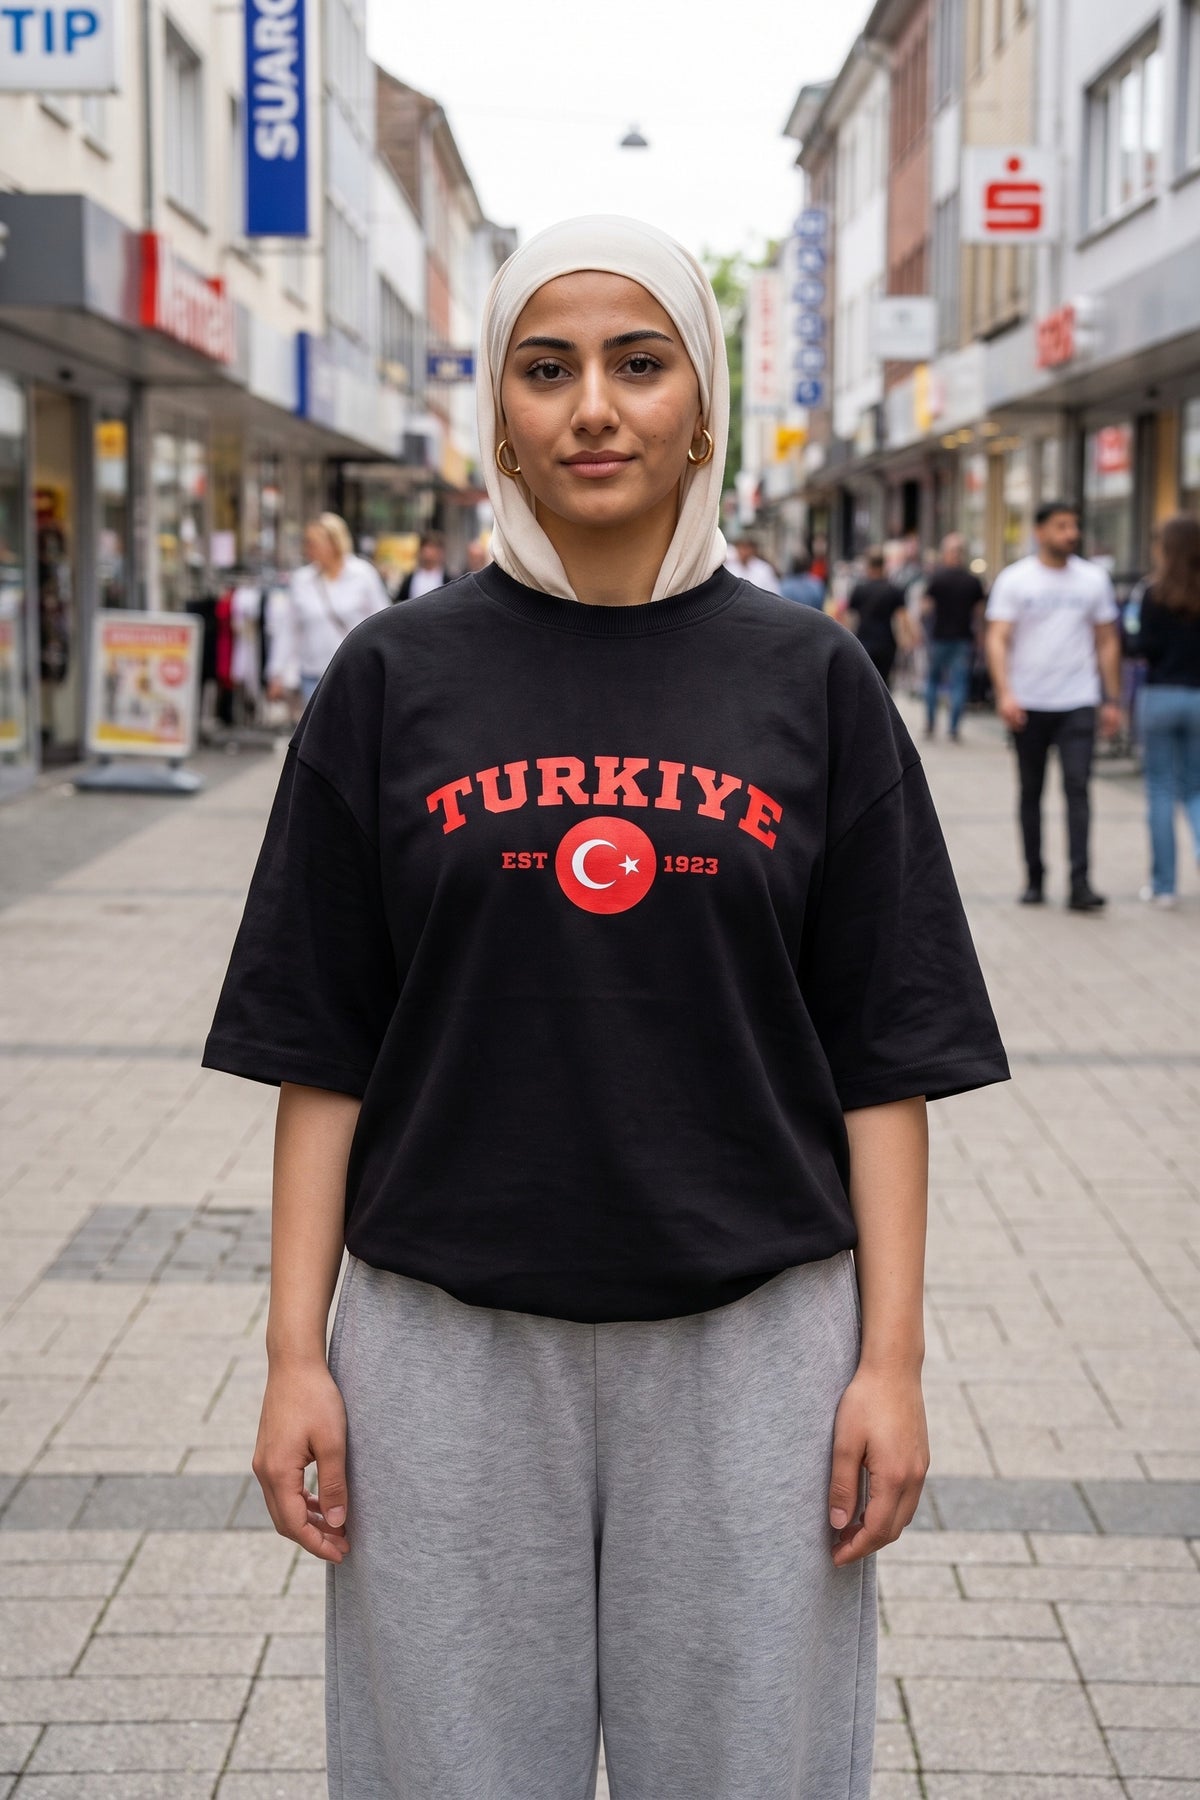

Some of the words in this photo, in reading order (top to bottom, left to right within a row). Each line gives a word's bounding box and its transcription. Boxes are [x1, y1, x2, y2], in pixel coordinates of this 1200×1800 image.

[0, 7, 99, 54] TIP
[426, 755, 783, 850] TURKIYE
[501, 852, 548, 869] EST
[664, 855, 719, 875] 1923
